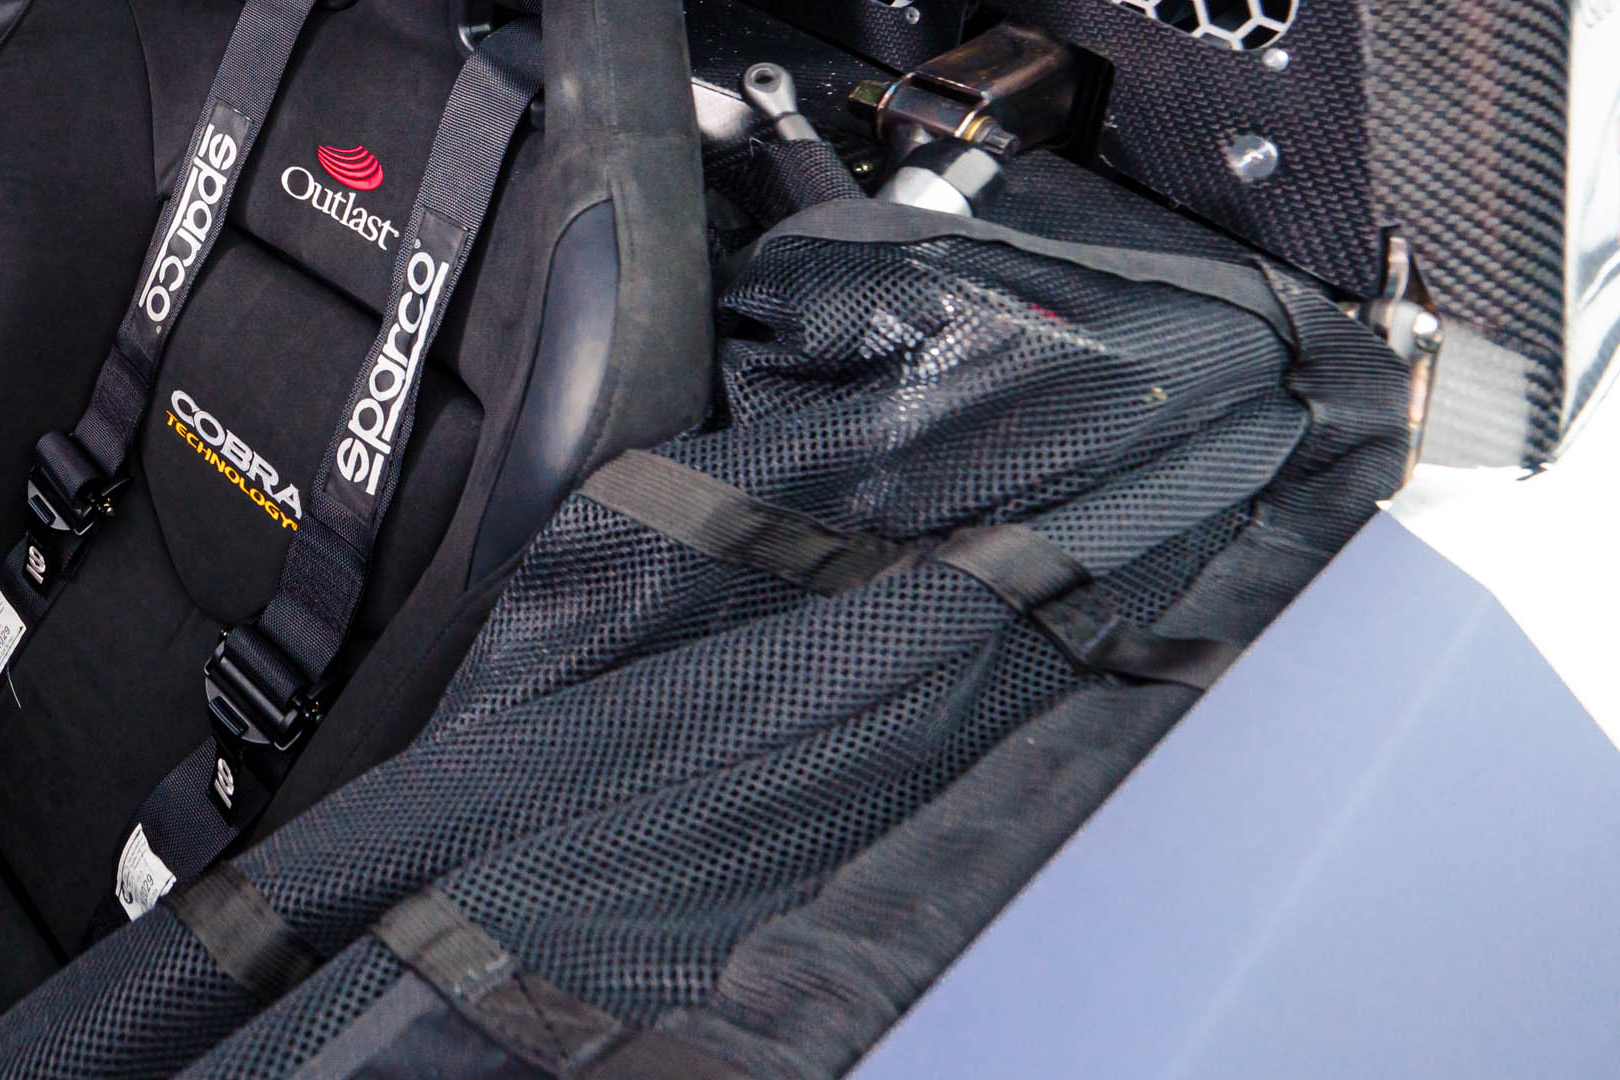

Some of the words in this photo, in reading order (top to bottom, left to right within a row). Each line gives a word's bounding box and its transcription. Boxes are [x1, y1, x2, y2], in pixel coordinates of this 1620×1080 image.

[138, 124, 237, 321] sparco
[281, 166, 398, 251] Outlast
[336, 250, 449, 496] sparco
[171, 390, 302, 520] COBRA
